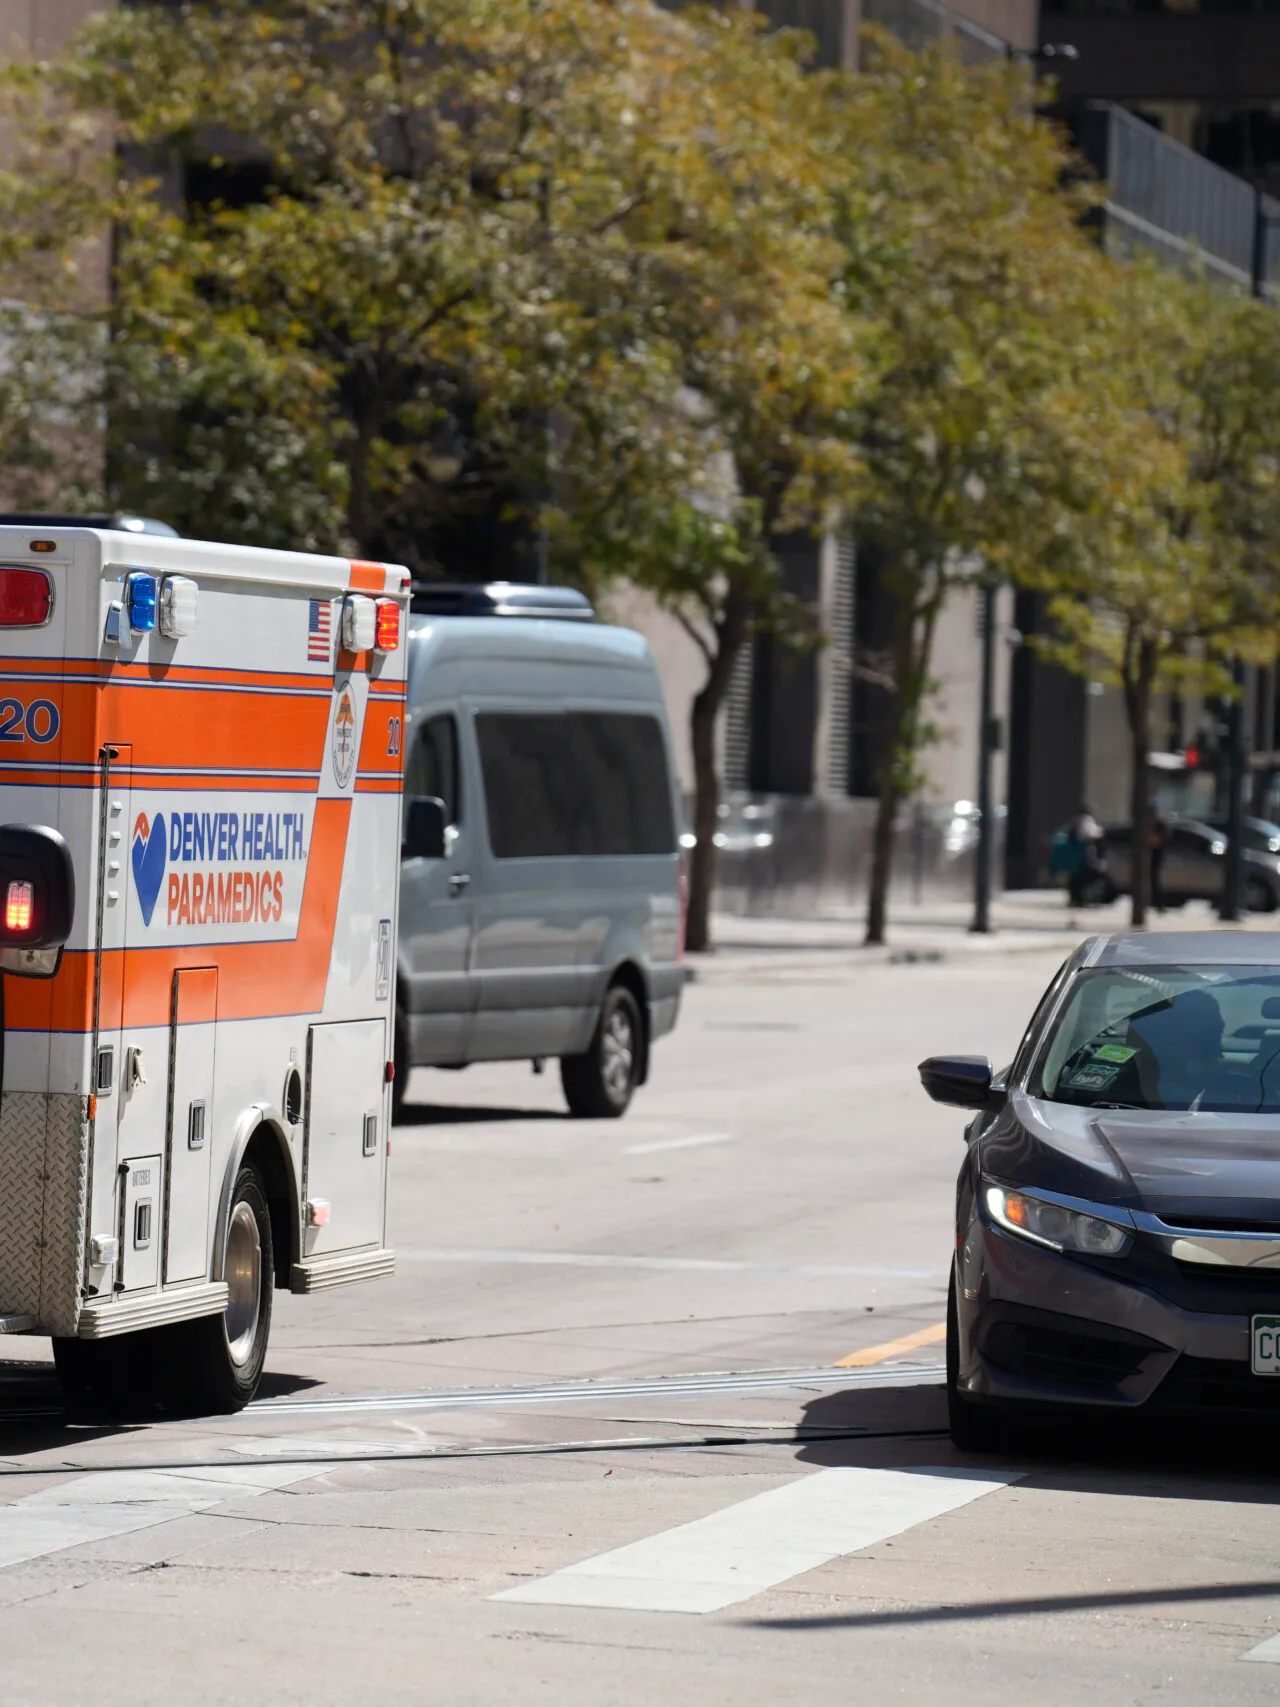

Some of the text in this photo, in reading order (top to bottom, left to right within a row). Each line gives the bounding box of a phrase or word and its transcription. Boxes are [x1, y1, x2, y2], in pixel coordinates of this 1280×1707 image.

[387, 716, 401, 756] 20
[170, 812, 304, 861] DENVER HEALTH
[167, 870, 283, 926] PARAMEDICS
